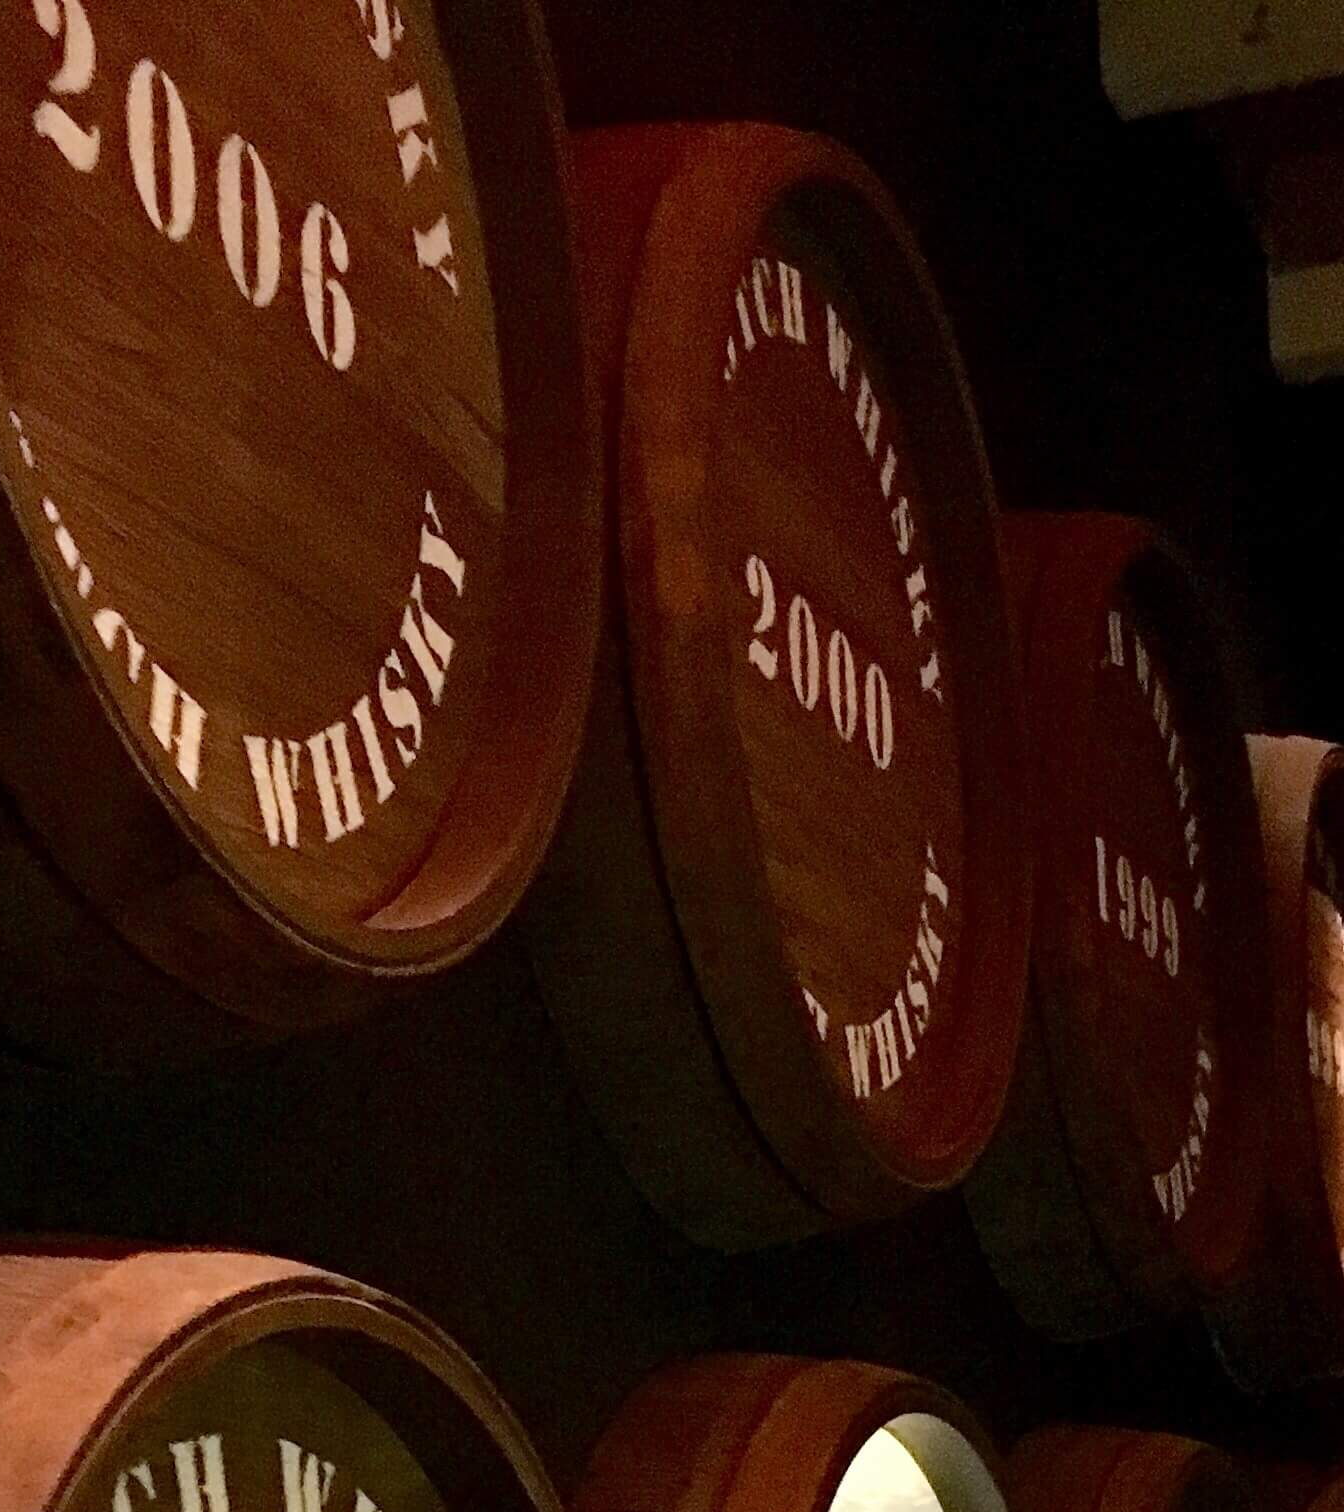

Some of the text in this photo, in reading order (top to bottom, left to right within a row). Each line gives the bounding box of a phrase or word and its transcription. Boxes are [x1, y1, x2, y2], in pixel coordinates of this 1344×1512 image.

[31, 0, 357, 372] 2006
[826, 303, 944, 705] WHISKY
[242, 490, 465, 848] WHISKY
[744, 554, 893, 771] 2000
[844, 840, 950, 1099] WHISKY
[1096, 835, 1179, 977] 1999
